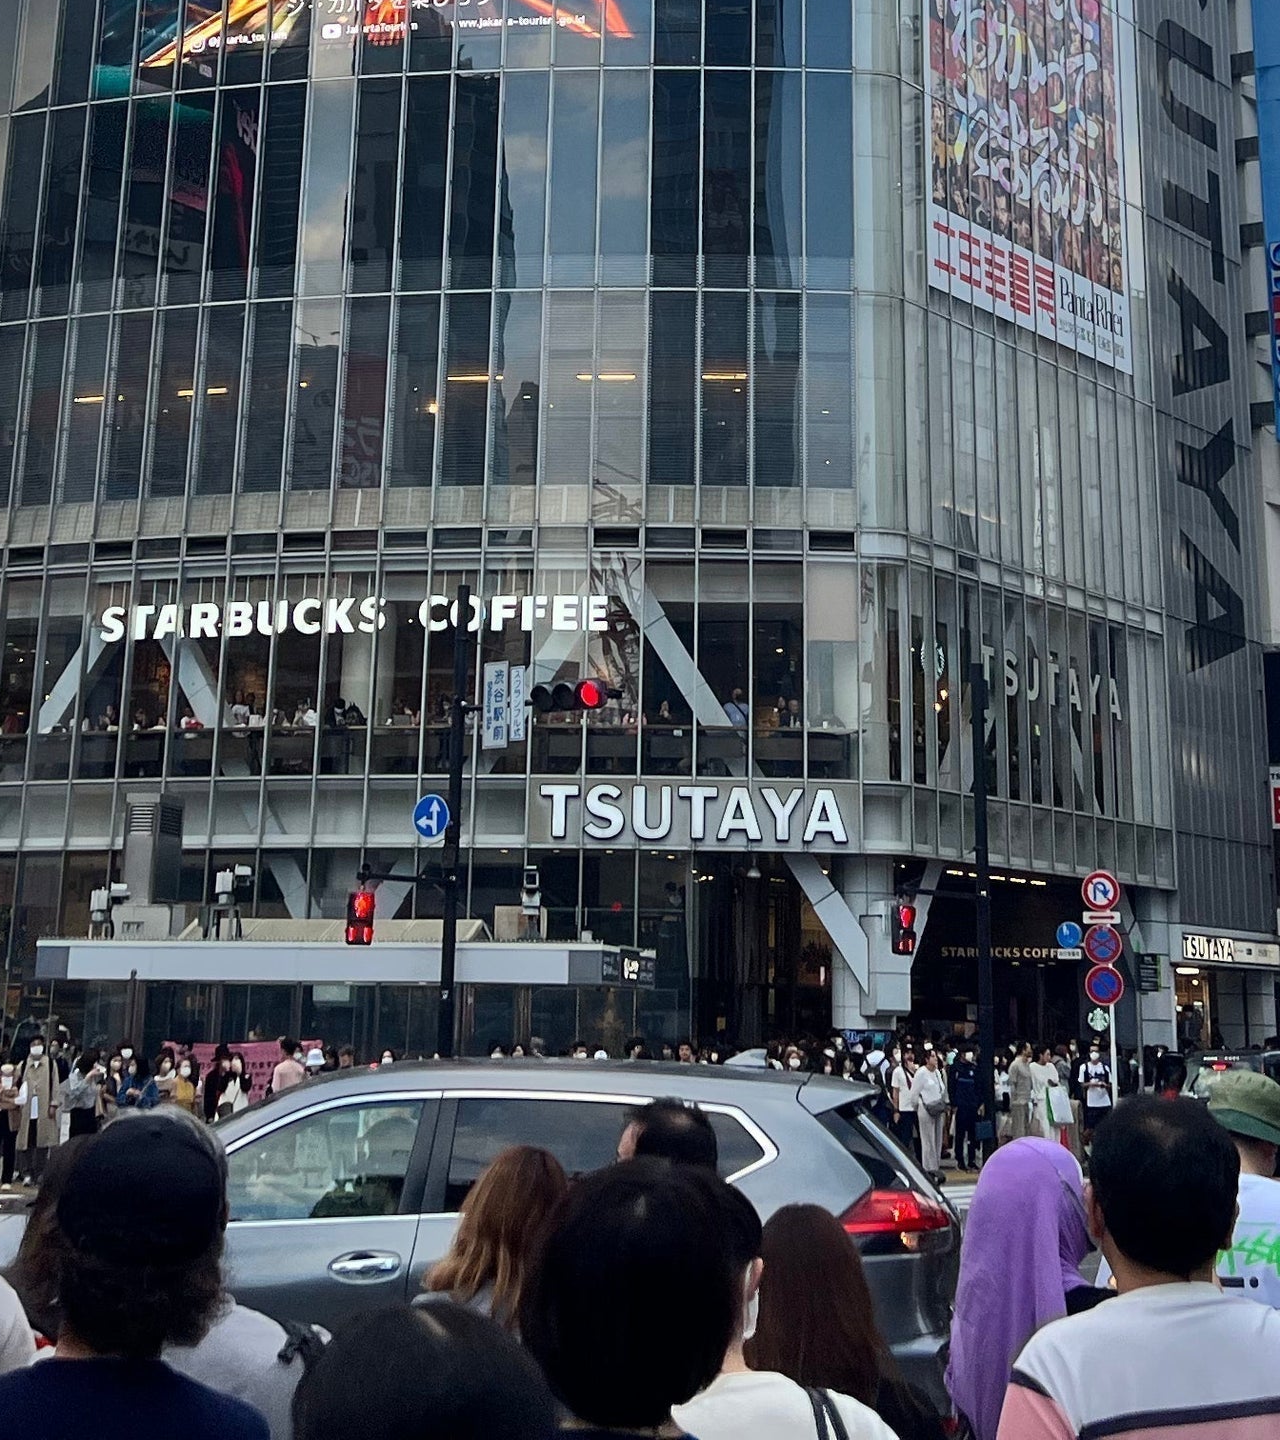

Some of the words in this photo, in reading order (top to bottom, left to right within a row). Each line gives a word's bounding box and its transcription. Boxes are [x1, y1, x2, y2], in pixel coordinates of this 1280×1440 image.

[100, 596, 387, 643] STARBUCKS
[419, 594, 610, 632] COFFEE
[493, 669, 505, 741] 渋谷駅前
[982, 645, 1121, 720] TSUTAYA
[539, 784, 848, 843] TSUTAYA
[941, 946, 1020, 958] STARCKS
[1023, 946, 1058, 959] COFF
[1182, 936, 1234, 962] TSUTAYA
